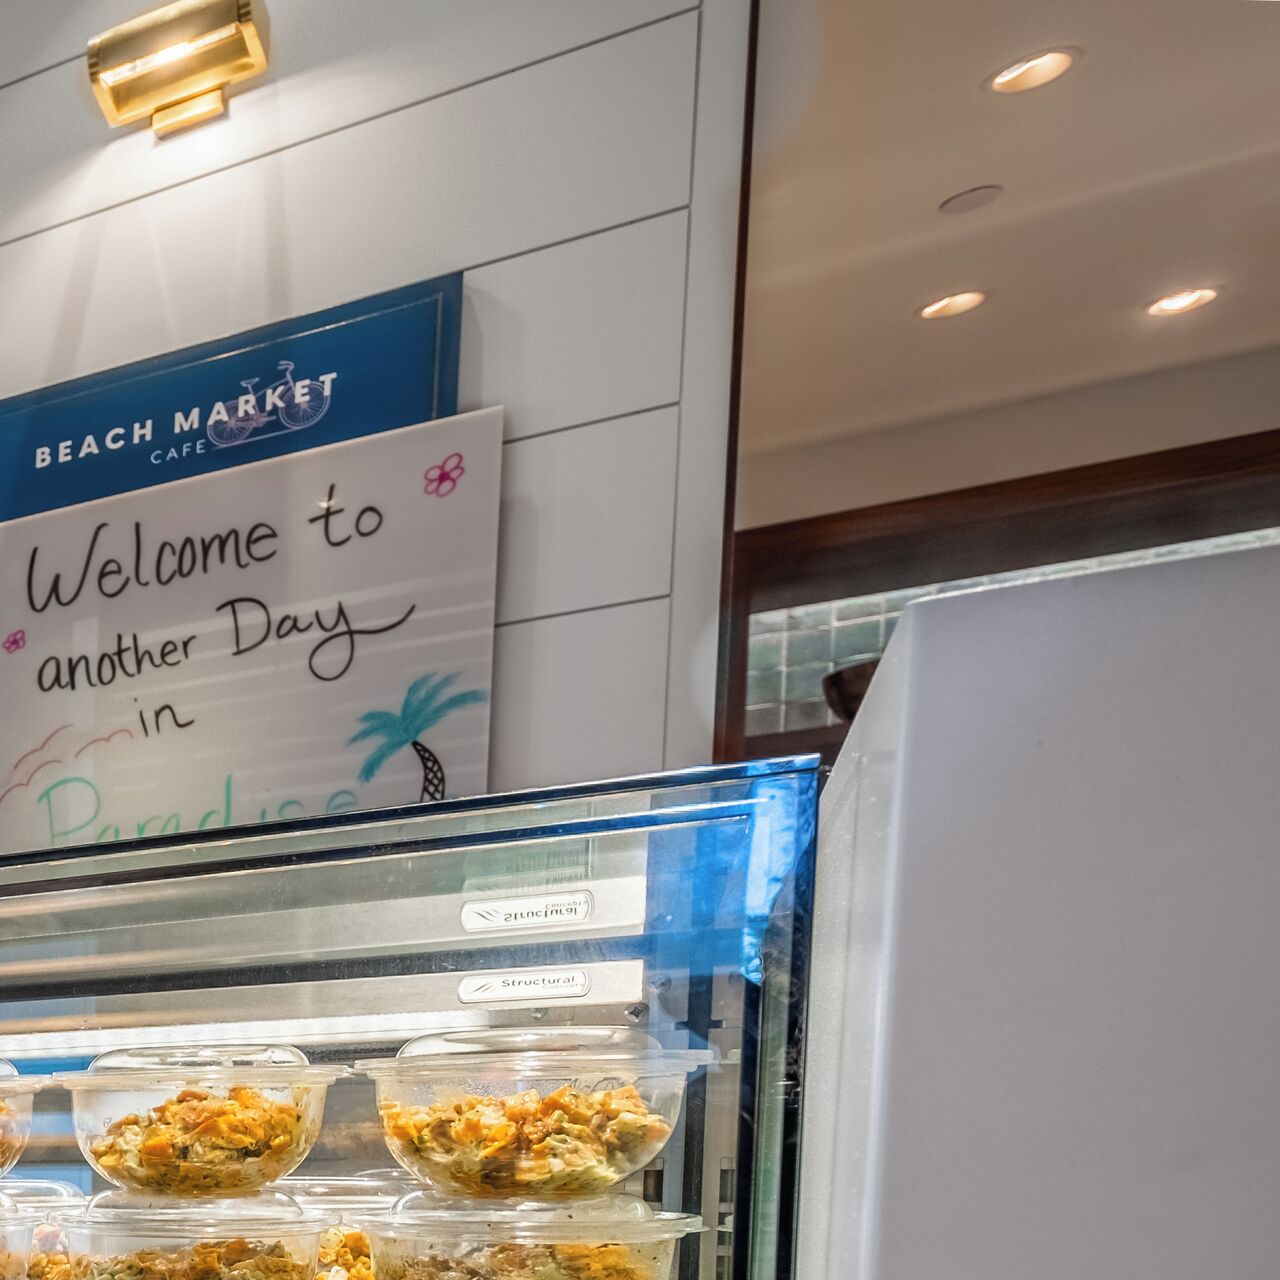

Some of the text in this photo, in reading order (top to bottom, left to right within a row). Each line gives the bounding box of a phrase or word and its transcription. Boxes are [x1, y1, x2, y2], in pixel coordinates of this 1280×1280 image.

[35, 372, 339, 469] BEACH MARKET
[150, 439, 206, 464] CAFE
[26, 484, 384, 613] Welcome to
[37, 597, 417, 693] another Day
[134, 698, 196, 738] in
[501, 974, 576, 988] Structural
